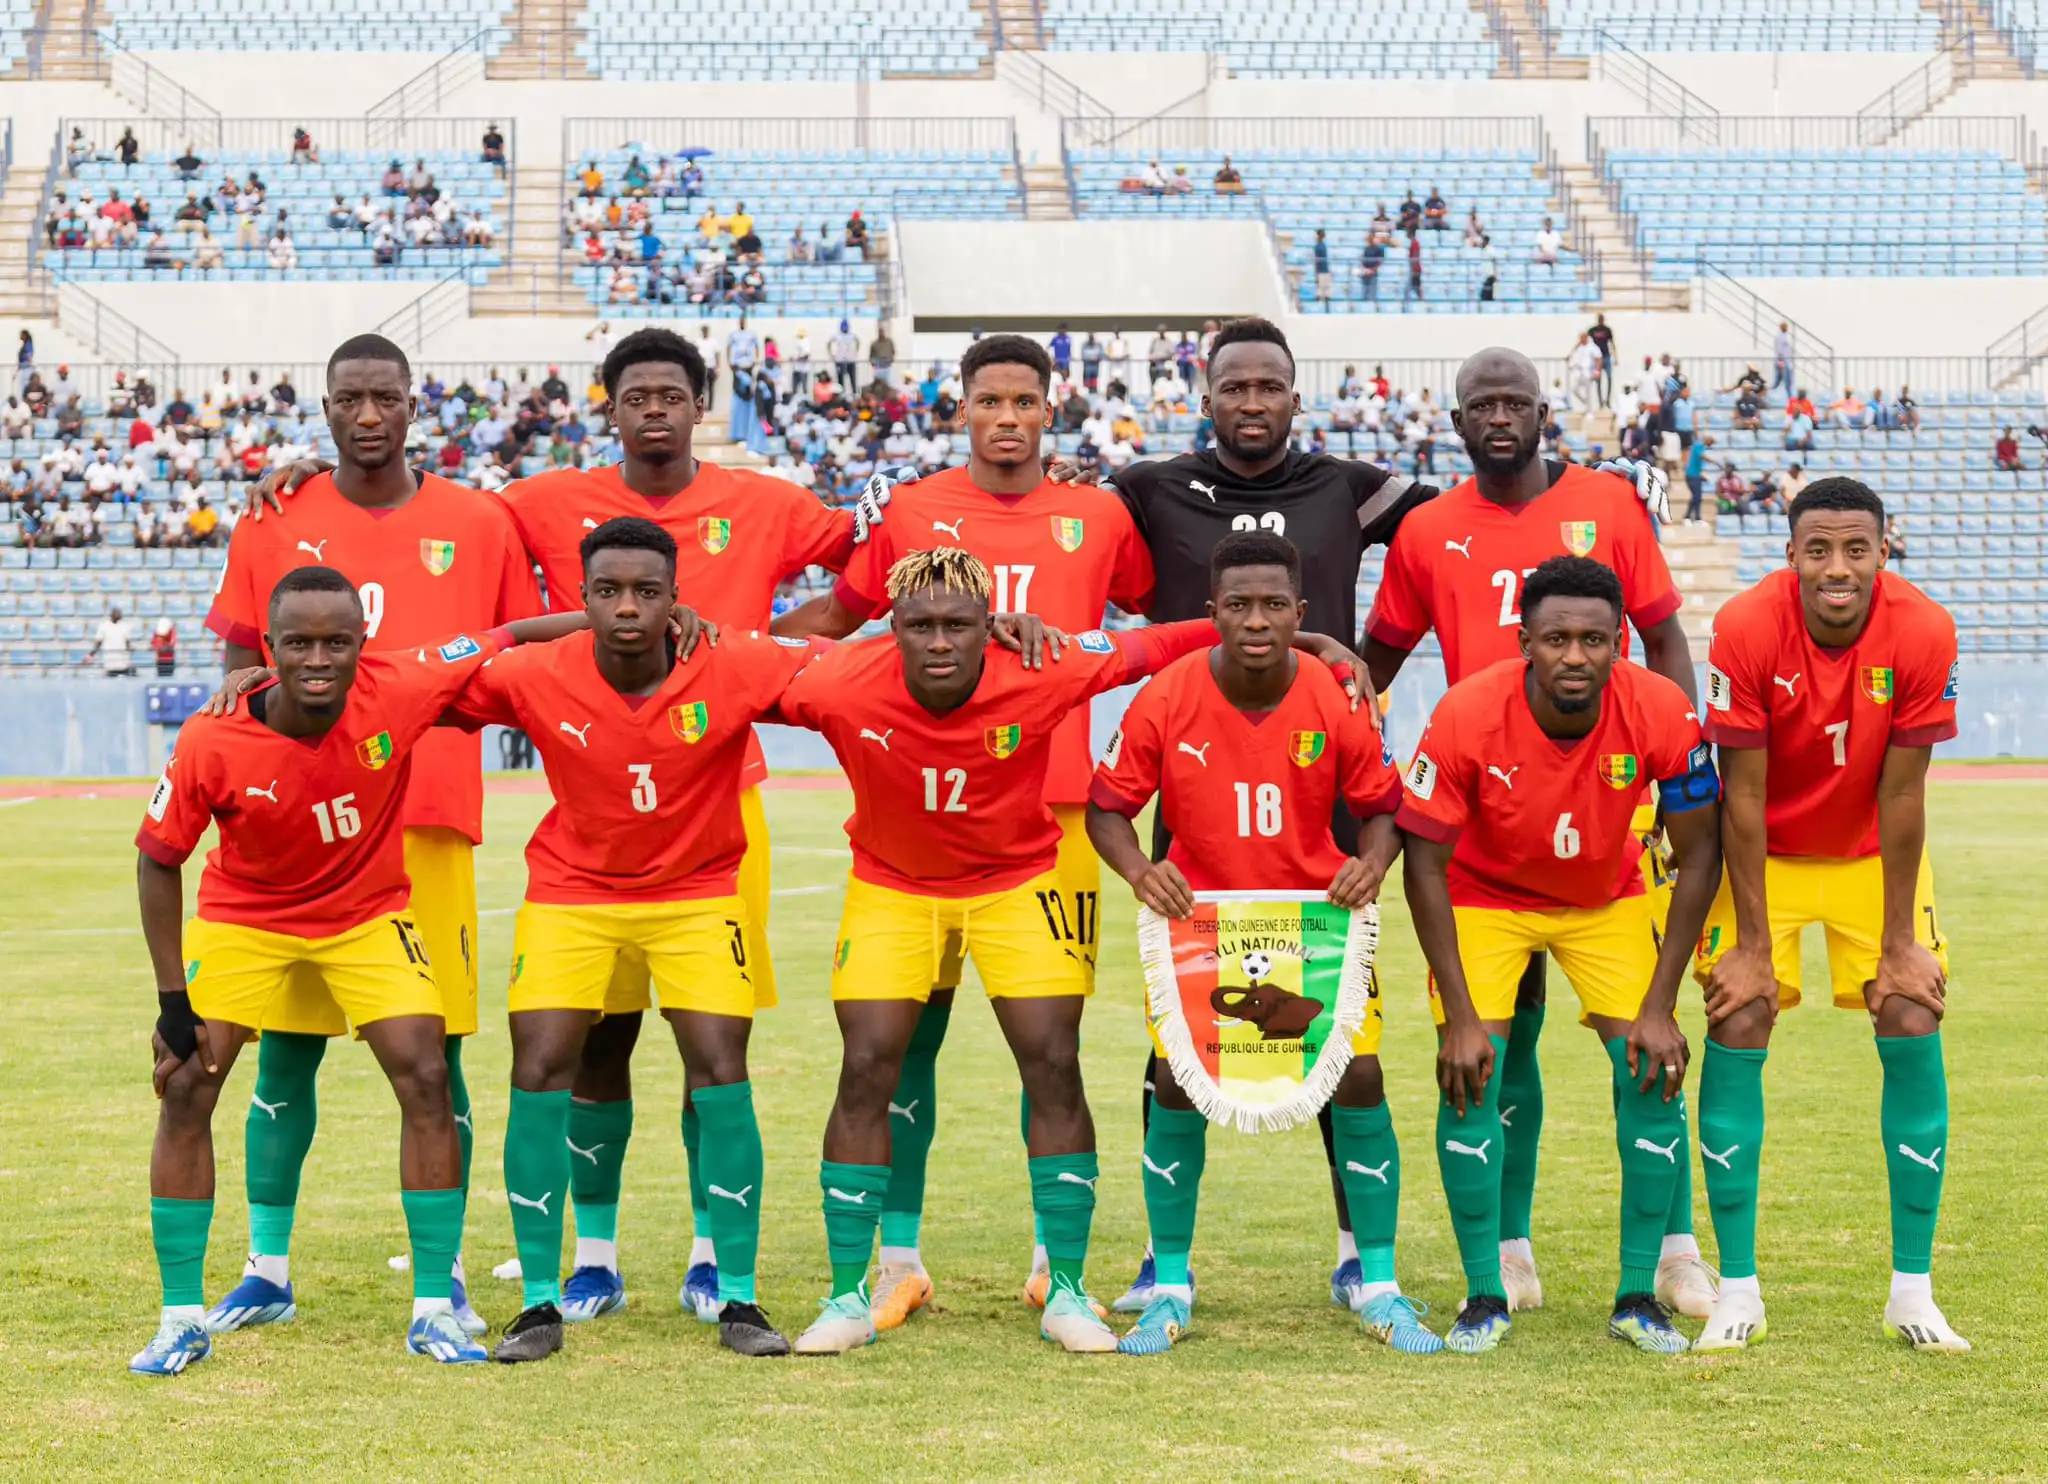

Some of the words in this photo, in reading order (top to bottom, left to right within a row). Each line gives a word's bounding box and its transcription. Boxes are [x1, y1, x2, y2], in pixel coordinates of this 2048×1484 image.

[358, 582, 384, 638] 9
[993, 564, 1036, 614] 17
[1491, 568, 1538, 627] 2
[1824, 719, 1849, 766] 7
[628, 764, 658, 813] 3
[921, 767, 968, 812] 12
[1233, 781, 1282, 838] 18
[1682, 770, 1714, 803] C
[311, 791, 362, 844] 15
[1553, 811, 1581, 859] 6
[1035, 888, 1075, 940] 12
[1075, 891, 1097, 945] 17
[1280, 919, 1290, 932] DE
[1291, 918, 1329, 932] FOOTBALL
[1241, 937, 1315, 964] NATIONAL
[1206, 1042, 1265, 1054] REPUBLIQUE
[1267, 1042, 1279, 1054] DE
[1281, 1042, 1317, 1054] GUINEE
